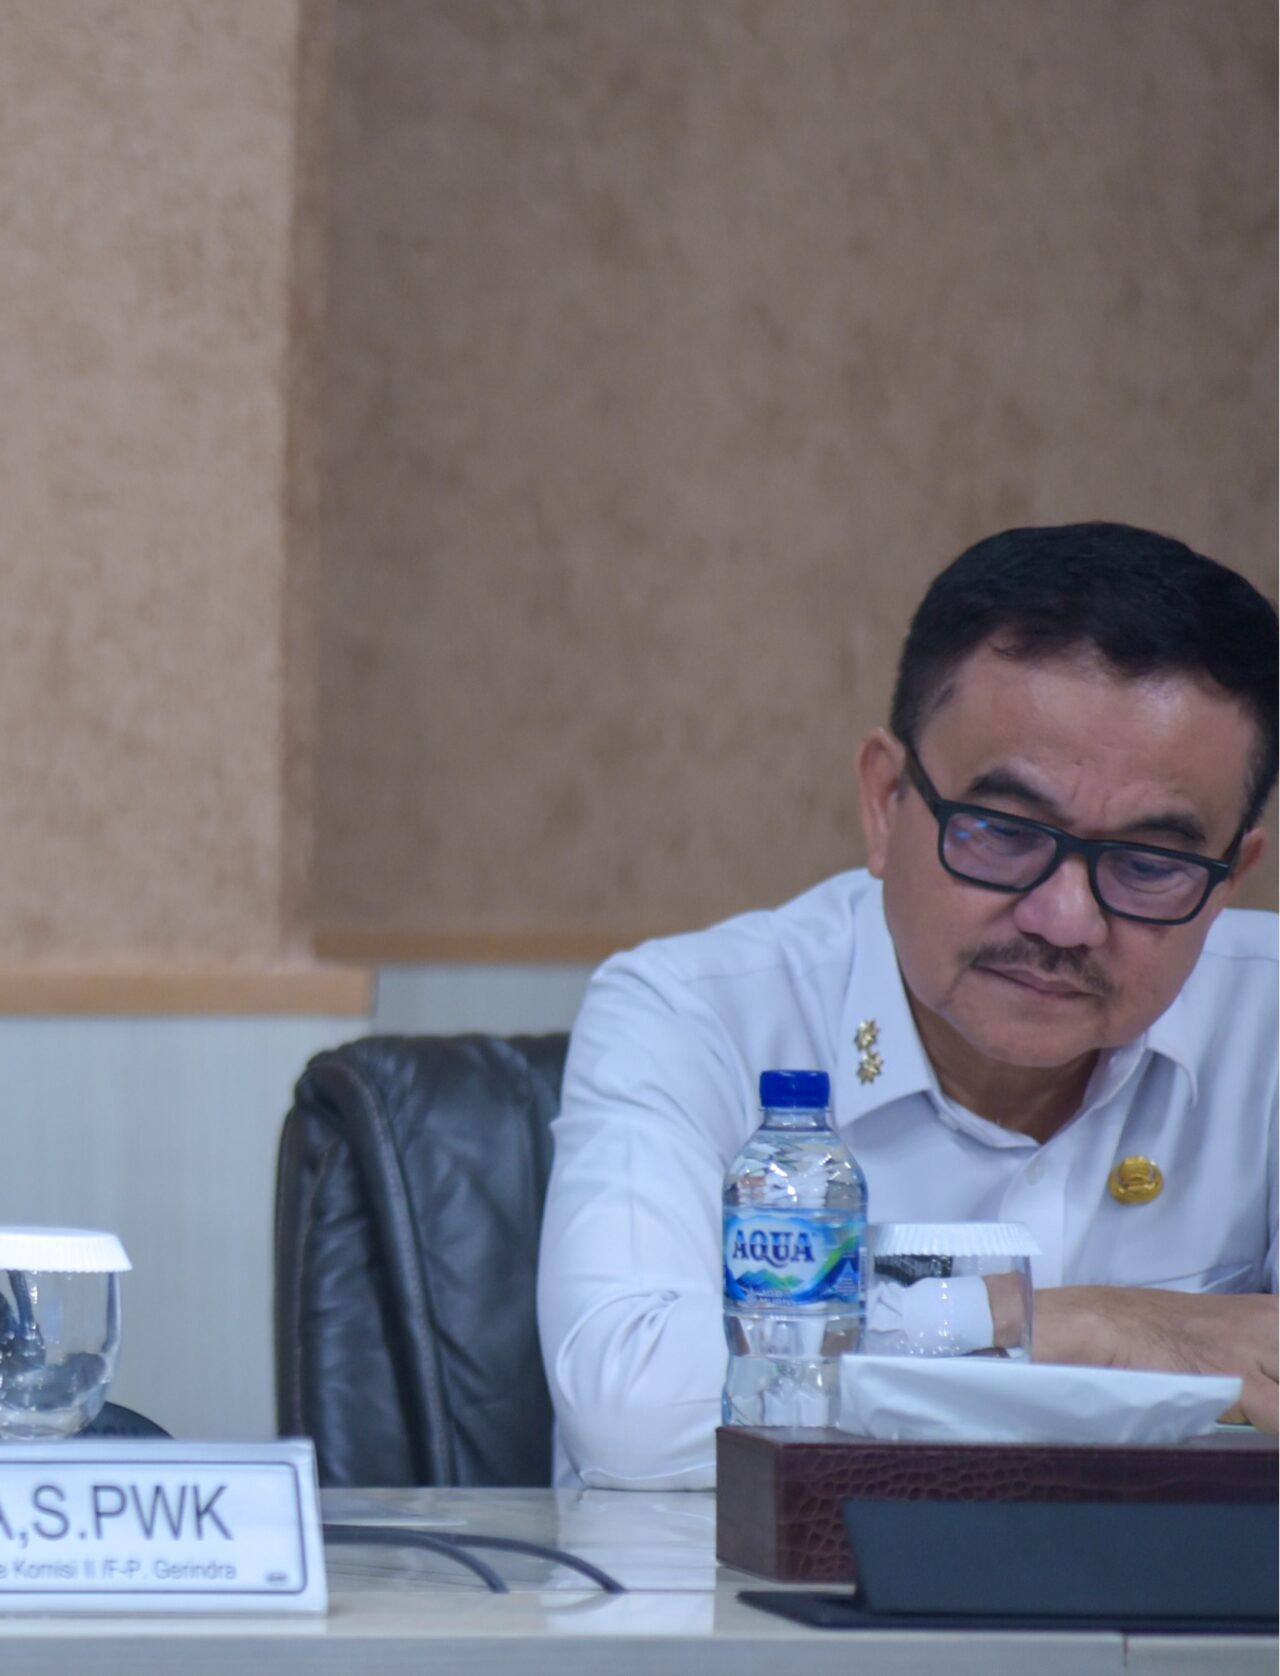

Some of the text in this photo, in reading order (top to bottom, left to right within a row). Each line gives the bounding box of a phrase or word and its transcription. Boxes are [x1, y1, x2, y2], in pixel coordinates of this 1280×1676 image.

[732, 1229, 815, 1268] AQUA
[12, 1560, 77, 1580] Komisi
[154, 1560, 237, 1580] Gerindra
